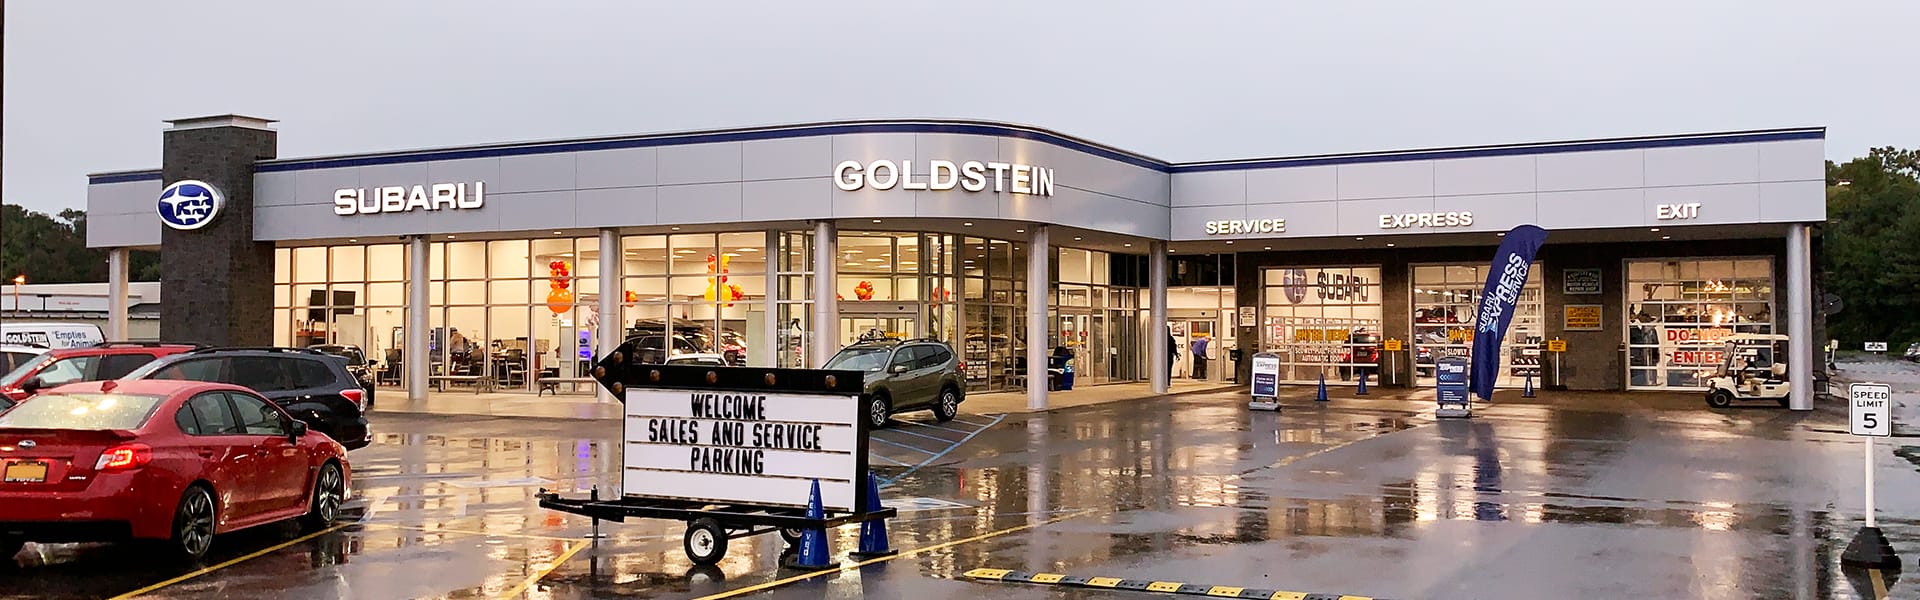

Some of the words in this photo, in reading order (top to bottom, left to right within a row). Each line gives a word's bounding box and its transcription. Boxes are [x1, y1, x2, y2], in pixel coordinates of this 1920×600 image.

[834, 160, 1054, 197] GOLDSTEIN
[334, 181, 485, 215] SUBARU
[1657, 203, 1701, 220] EXIT
[1206, 218, 1286, 235] SERVICE
[1379, 211, 1473, 229] EXPRESS
[1317, 271, 1368, 302] SUBARU
[1487, 253, 1522, 328] EXPRESS
[1507, 260, 1529, 306] SERVICE
[1479, 291, 1495, 333] SUBARU
[1667, 329, 1689, 341] DO
[691, 394, 766, 420] WELCOME
[1854, 391, 1887, 399] SPEED
[649, 419, 698, 444] SALES
[712, 422, 744, 446] AND
[753, 423, 822, 450] SERVICE
[1864, 413, 1877, 428] 5
[691, 447, 764, 474] PARKING
[803, 494, 815, 556] RESVED
